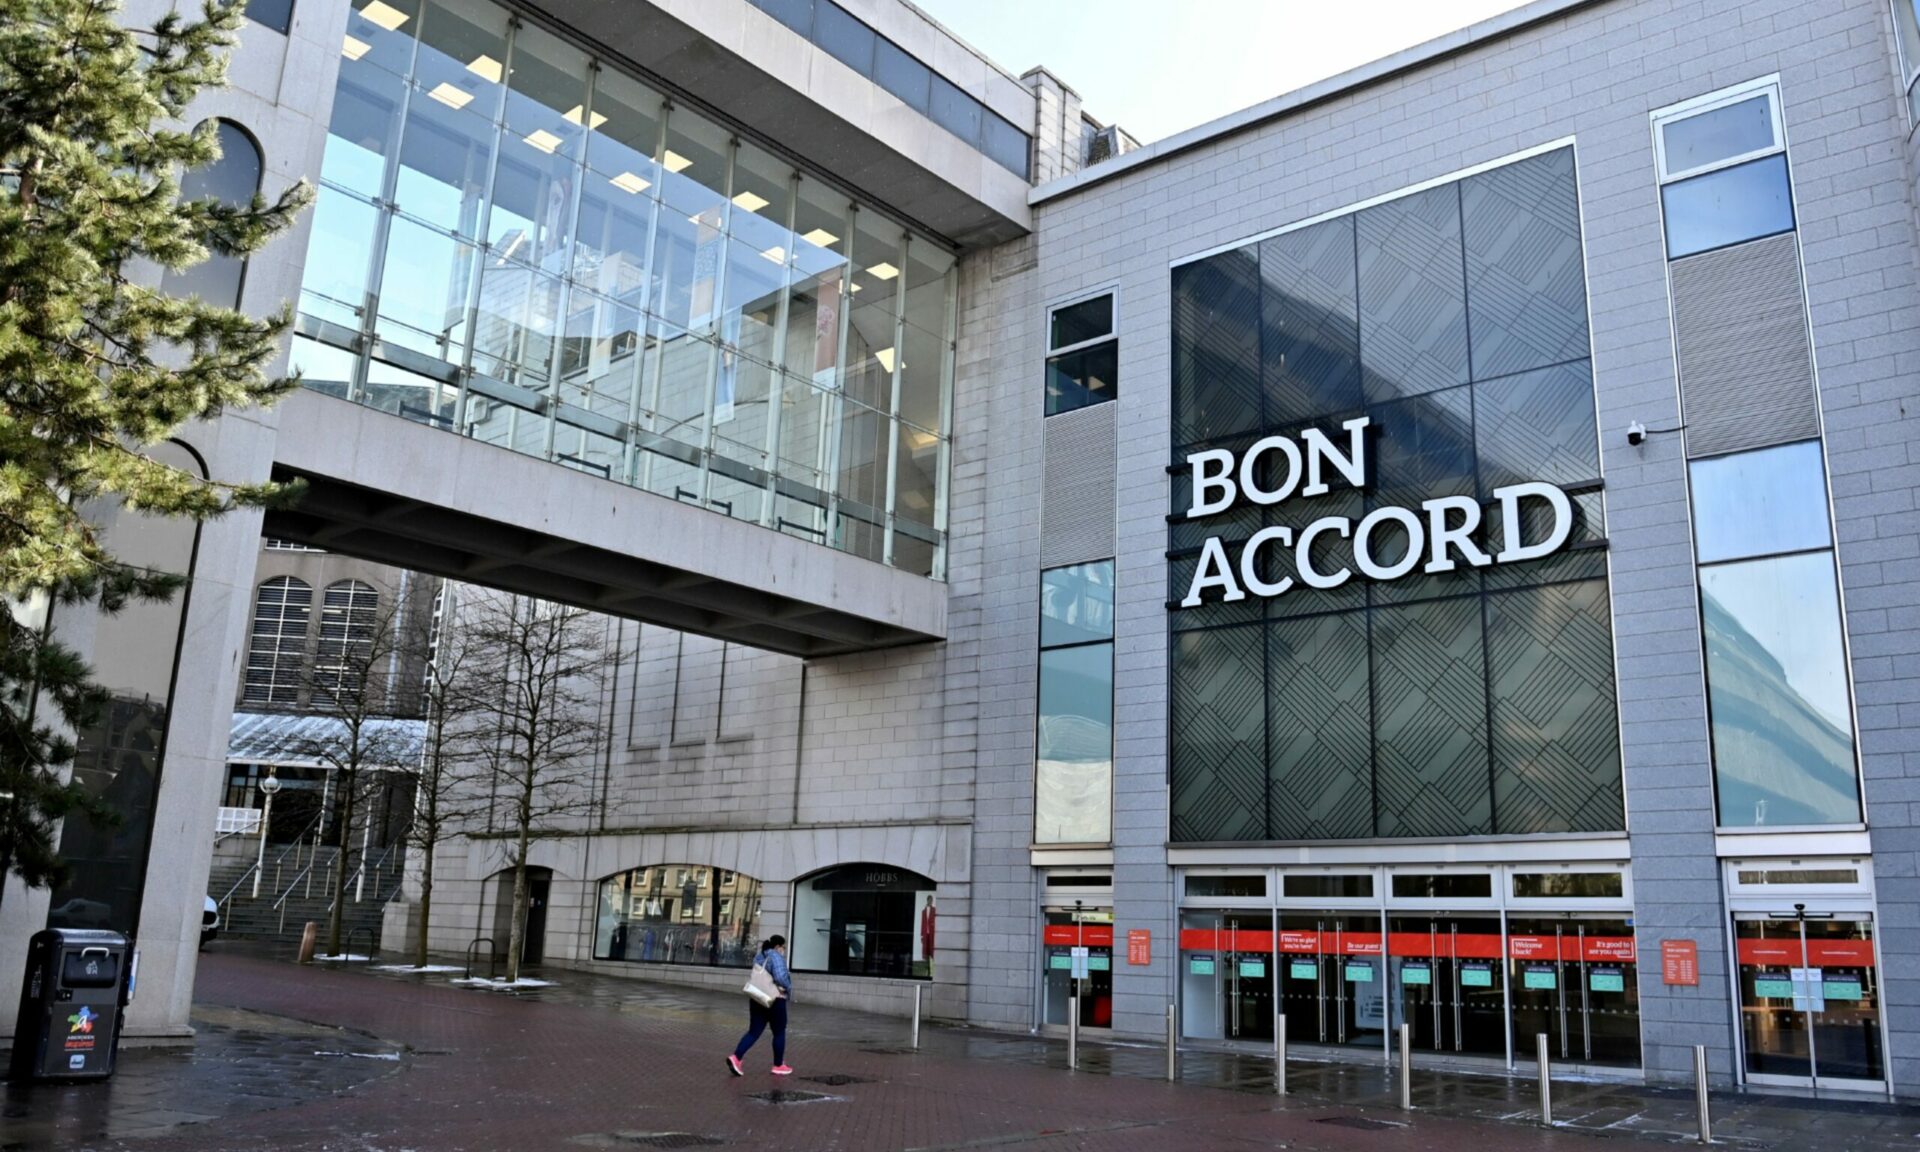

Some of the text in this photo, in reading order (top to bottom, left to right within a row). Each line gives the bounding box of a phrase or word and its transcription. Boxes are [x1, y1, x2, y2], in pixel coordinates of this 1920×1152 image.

[1186, 416, 1371, 518] BON
[1181, 481, 1573, 608] ACCORD
[865, 872, 898, 882] HOBBS
